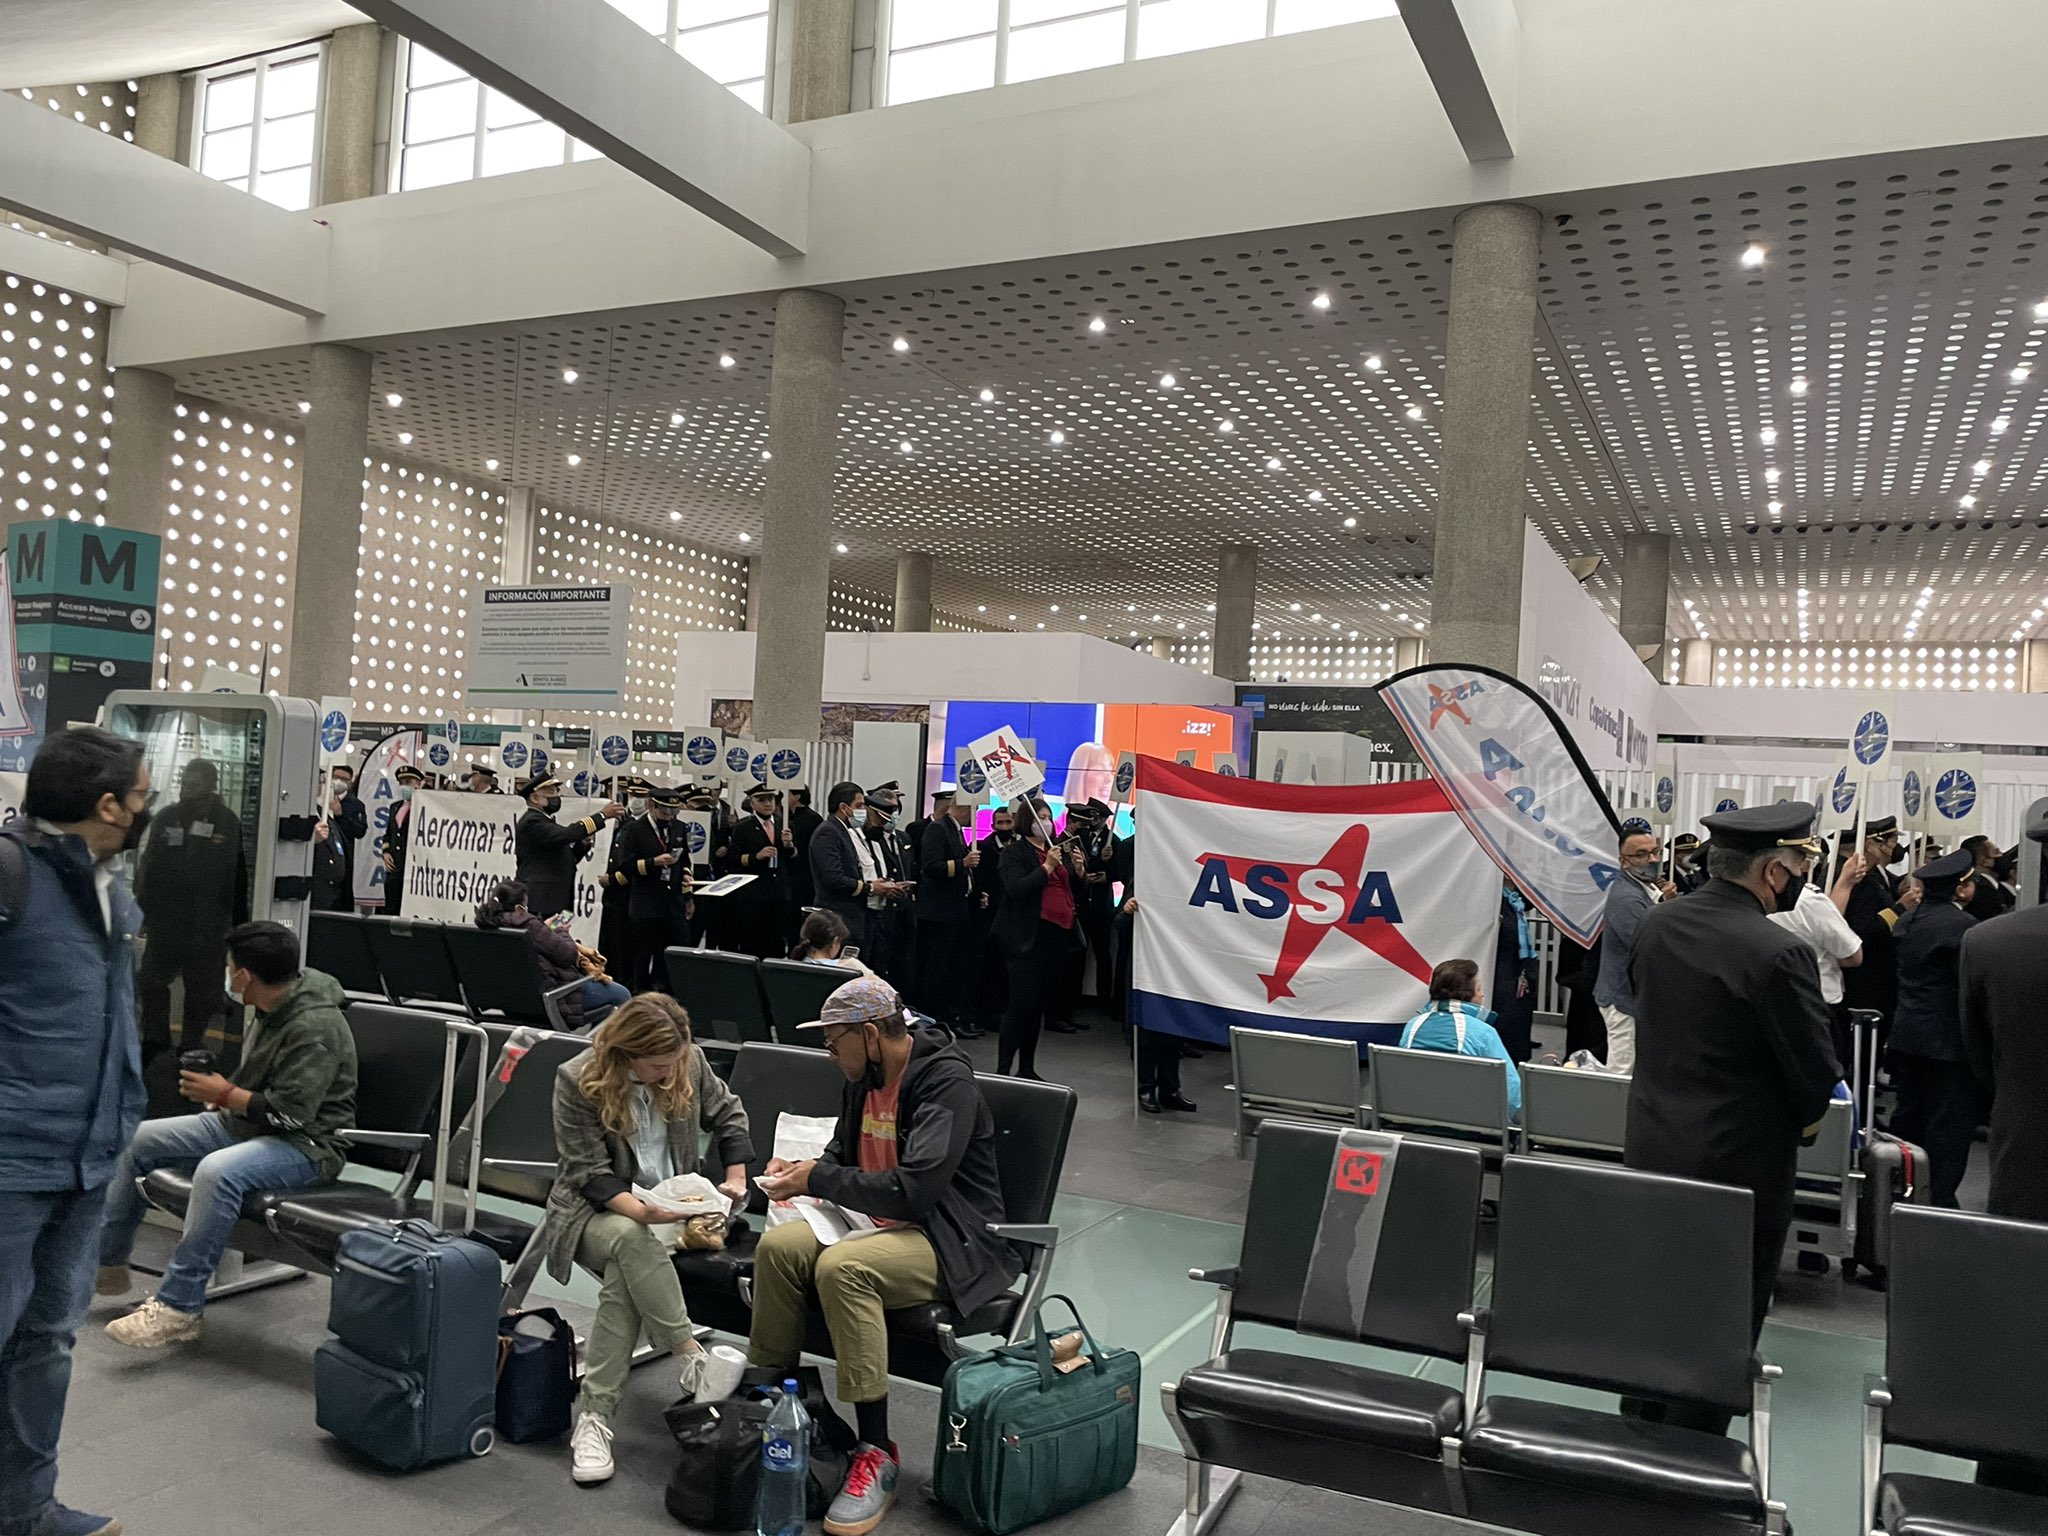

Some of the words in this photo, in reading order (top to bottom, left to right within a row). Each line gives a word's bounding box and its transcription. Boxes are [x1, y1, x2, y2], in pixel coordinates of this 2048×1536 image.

[16, 531, 46, 583] M
[80, 533, 137, 591] M
[488, 589, 549, 601] INFORMACIÓN
[550, 589, 606, 600] IMPORTANTE
[1344, 704, 1361, 712] ELLA
[634, 735, 652, 746] A-F
[1371, 742, 1394, 754] ex,
[415, 806, 496, 853] Aeromar
[410, 855, 510, 905] intransige
[1188, 858, 1404, 925] ASSA
[768, 1442, 792, 1459] ciel
